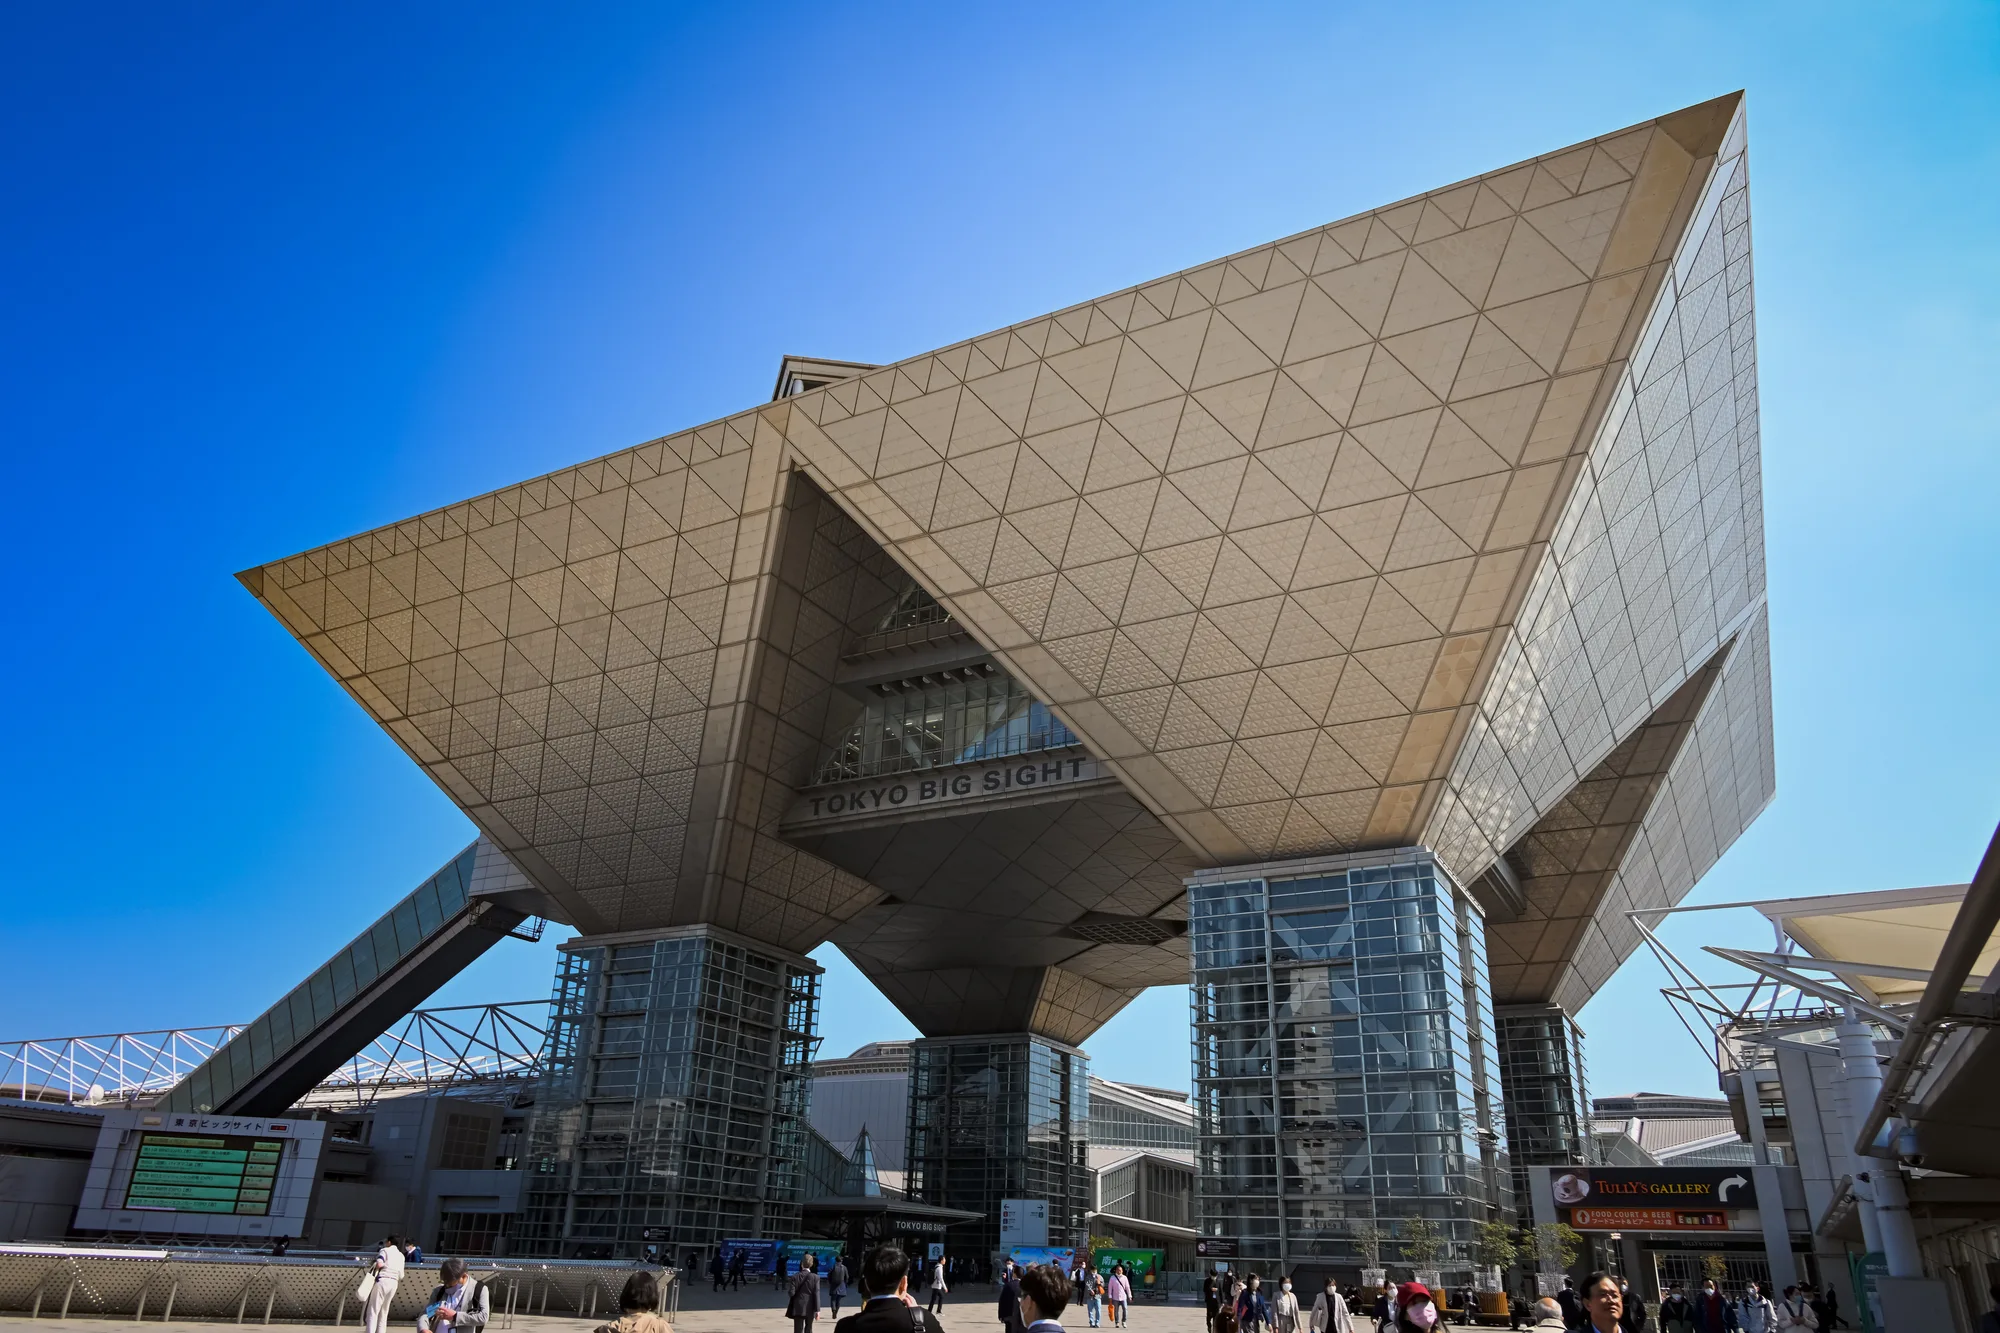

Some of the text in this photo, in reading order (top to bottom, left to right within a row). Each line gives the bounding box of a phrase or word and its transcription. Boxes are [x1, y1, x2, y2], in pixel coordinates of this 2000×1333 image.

[809, 757, 1087, 816] TOKYO BIG SIGHT
[174, 1118, 262, 1130] 東京ビッグサイト
[1595, 1180, 1711, 1194] TULLY'S GALLERY
[896, 1221, 921, 1230] TOKYO
[922, 1222, 932, 1231] BIG
